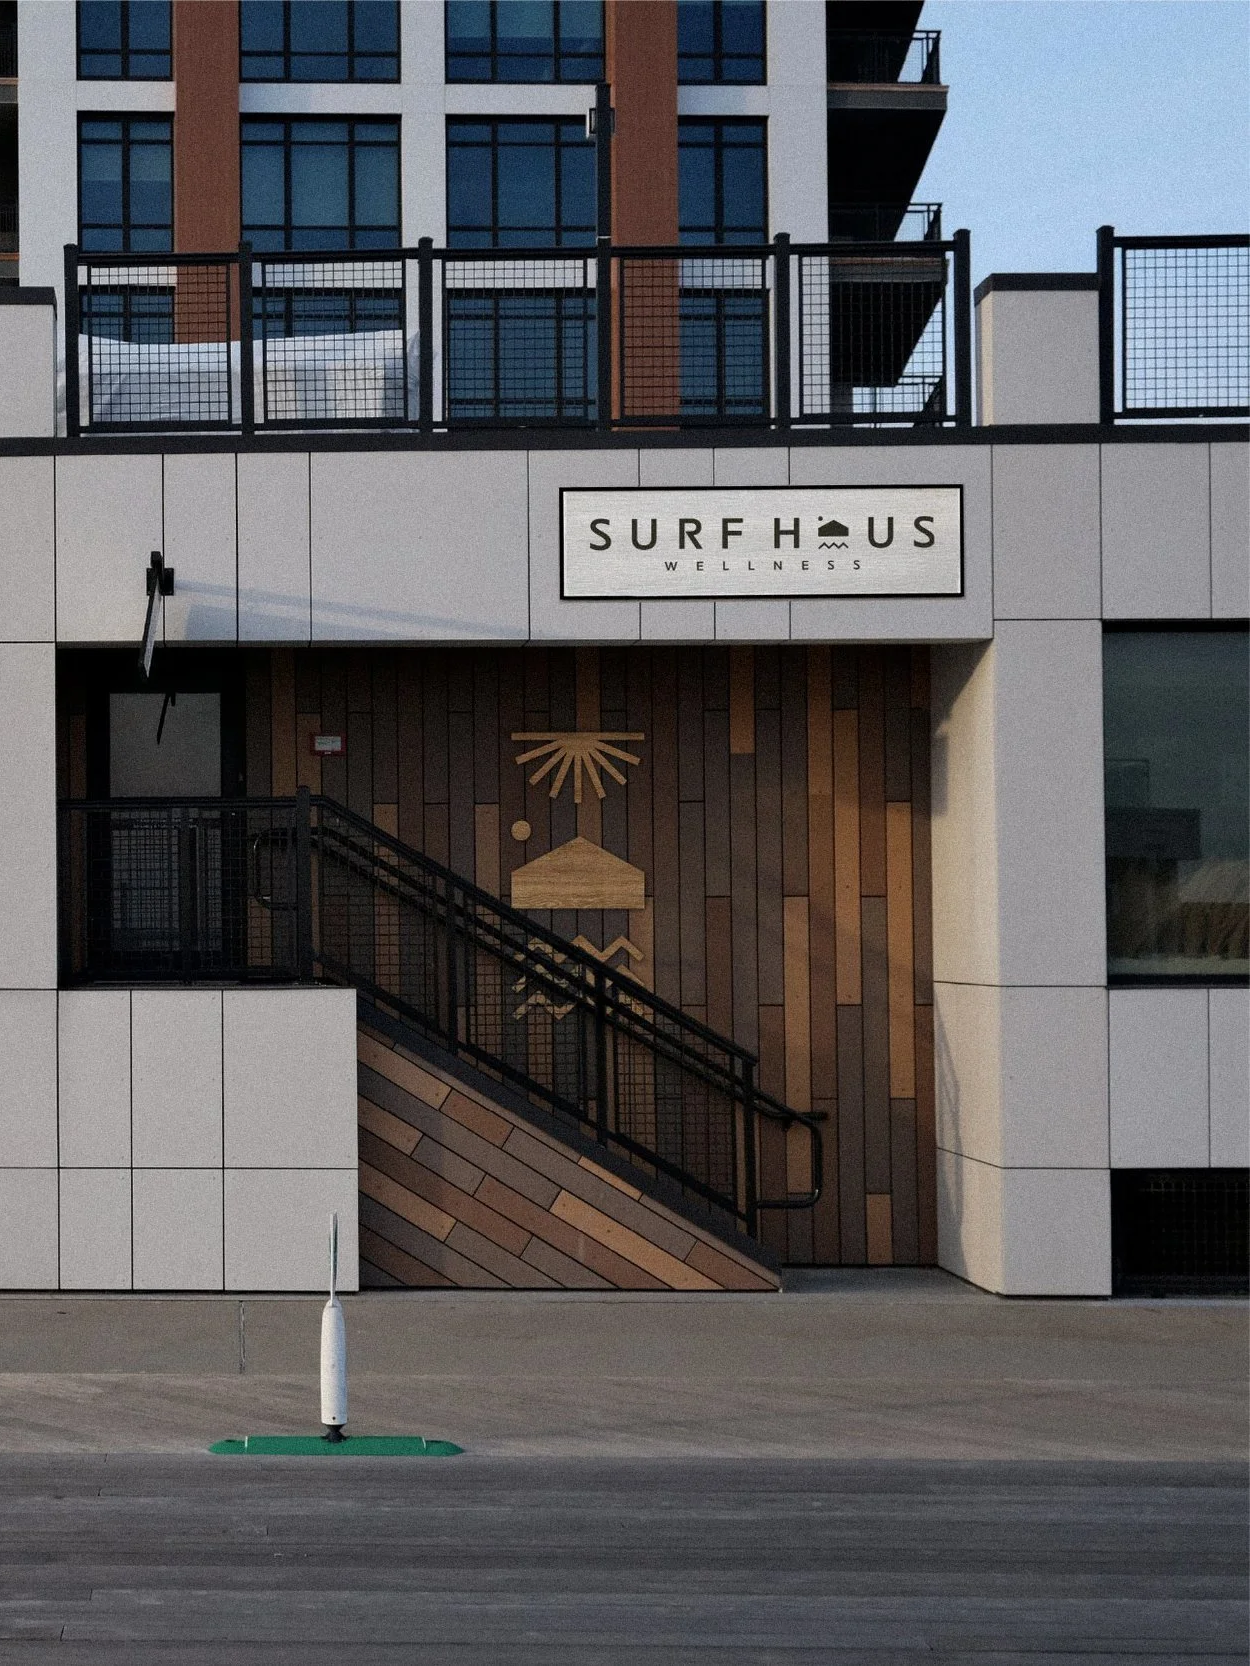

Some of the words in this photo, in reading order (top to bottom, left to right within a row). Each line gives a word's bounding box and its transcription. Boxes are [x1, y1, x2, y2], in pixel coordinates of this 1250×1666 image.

[589, 517, 745, 551] SURF
[773, 515, 936, 550] HUS
[664, 559, 861, 572] WELLNESS
